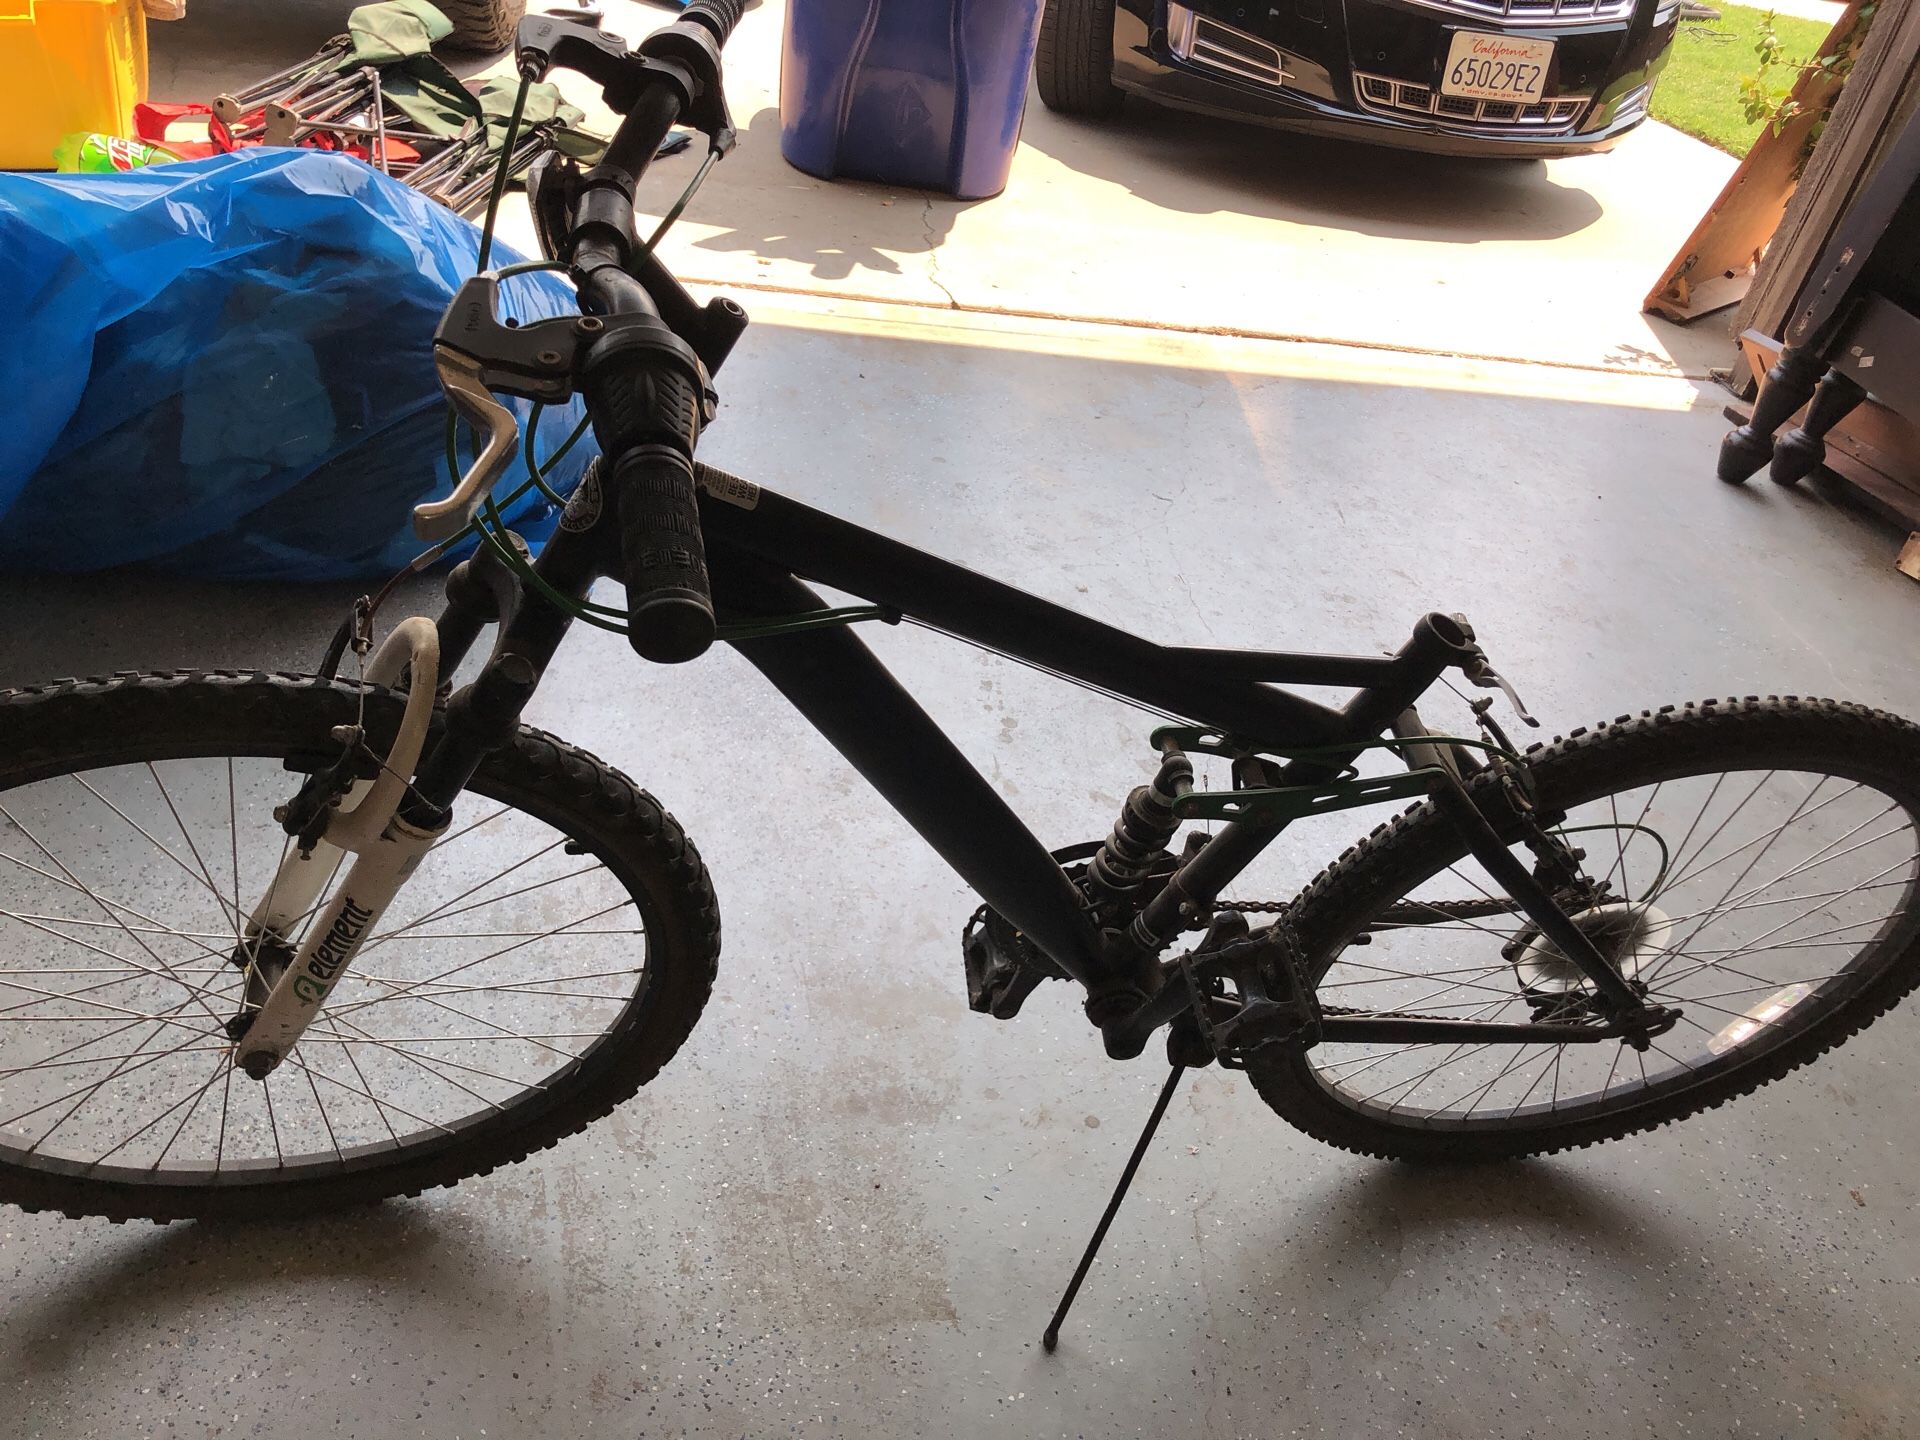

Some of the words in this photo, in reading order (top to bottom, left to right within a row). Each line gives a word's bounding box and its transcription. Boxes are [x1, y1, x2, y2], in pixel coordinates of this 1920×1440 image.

[1472, 39, 1534, 60] California
[1451, 57, 1541, 94] 65029E2
[307, 896, 374, 980] element
